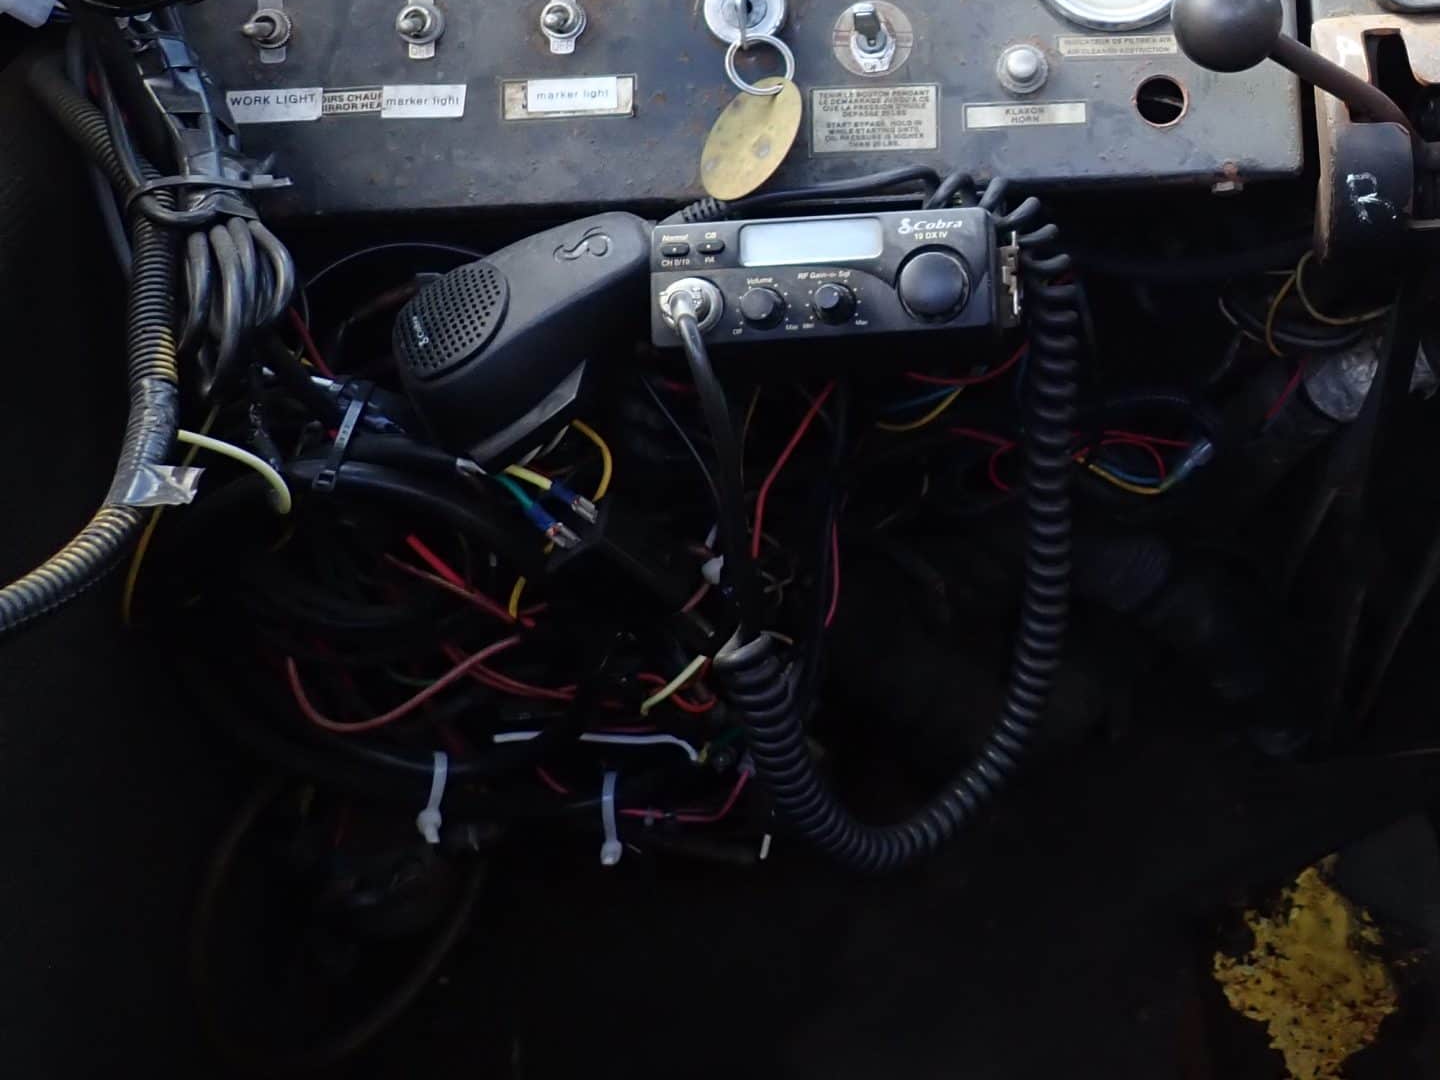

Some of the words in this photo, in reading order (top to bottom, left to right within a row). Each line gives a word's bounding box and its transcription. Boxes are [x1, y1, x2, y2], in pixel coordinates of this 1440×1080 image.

[536, 90, 580, 102] marker
[583, 86, 610, 101] light
[892, 88, 930, 97] PENDANT
[230, 95, 271, 107] WORK
[275, 93, 315, 106] LIGHT
[386, 96, 428, 108] marker
[432, 94, 460, 109] light
[1004, 107, 1045, 115] KLAXON
[1011, 115, 1040, 123] HORN
[826, 121, 852, 129] START
[913, 218, 963, 231] Cobra
